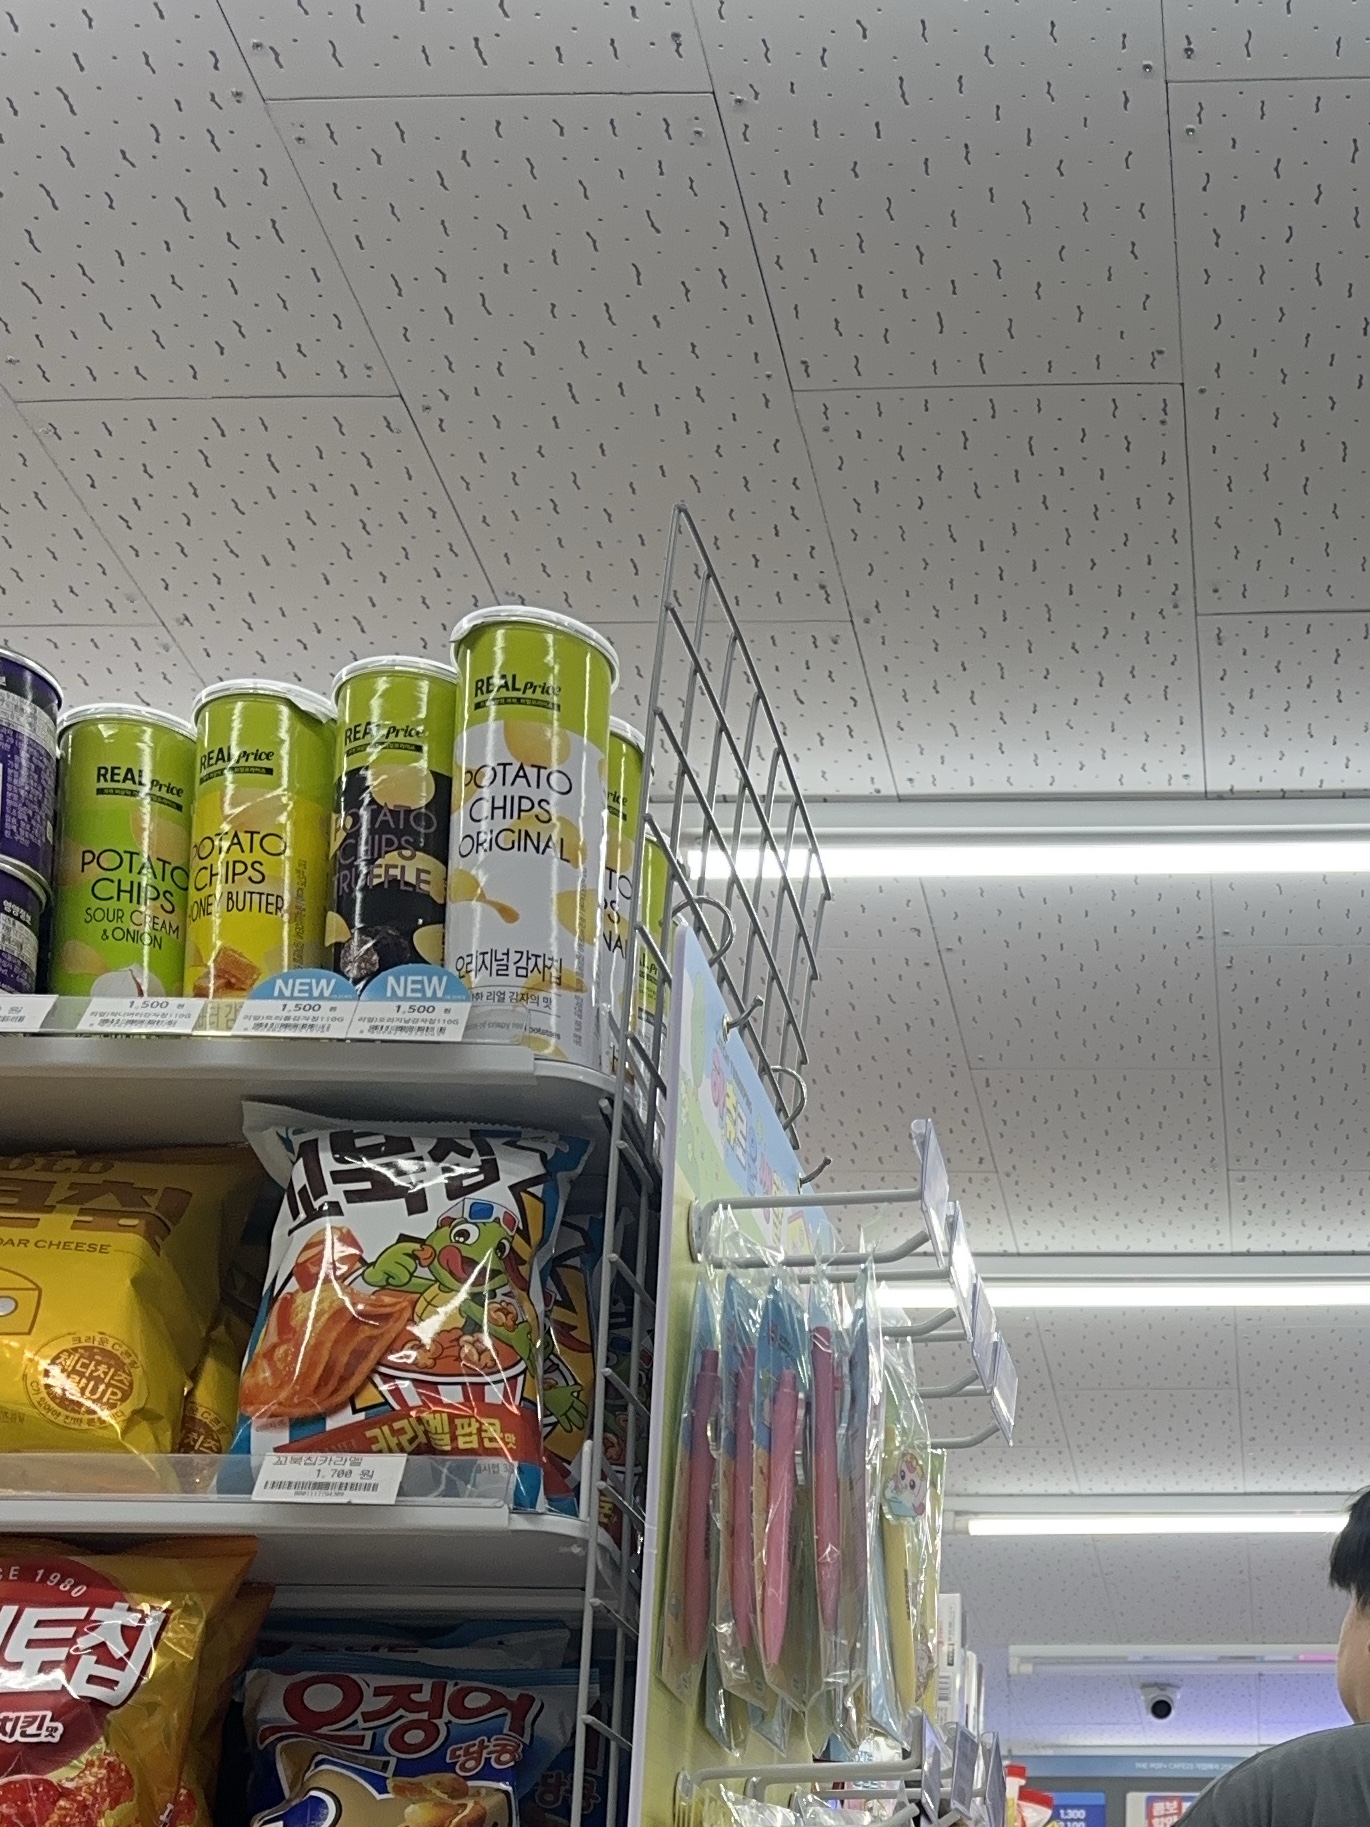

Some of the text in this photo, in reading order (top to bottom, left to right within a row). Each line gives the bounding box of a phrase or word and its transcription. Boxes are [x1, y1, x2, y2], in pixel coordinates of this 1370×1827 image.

[474, 673, 522, 698] REAL
[464, 762, 573, 796] POTATO
[469, 795, 553, 824] CHIPS
[458, 827, 571, 863] ORIGINAL
[82, 849, 189, 892] POTATO
[193, 860, 266, 891] CHIPS
[91, 878, 176, 914] CHIPS
[226, 891, 286, 917] BUTTER
[84, 907, 180, 940] SOUR CREAM
[111, 926, 163, 950] ONION
[454, 948, 564, 986] 오리지널 감자칩
[273, 977, 336, 998] NEW
[386, 975, 448, 998] NEW
[280, 1003, 322, 1013] 1,500
[395, 1004, 436, 1014] 1,500
[34, 1238, 112, 1255] CHEESE
[34, 1567, 87, 1598] 1980
[258, 1672, 537, 1756] 오징어
[447, 1735, 523, 1777] 땅콩
